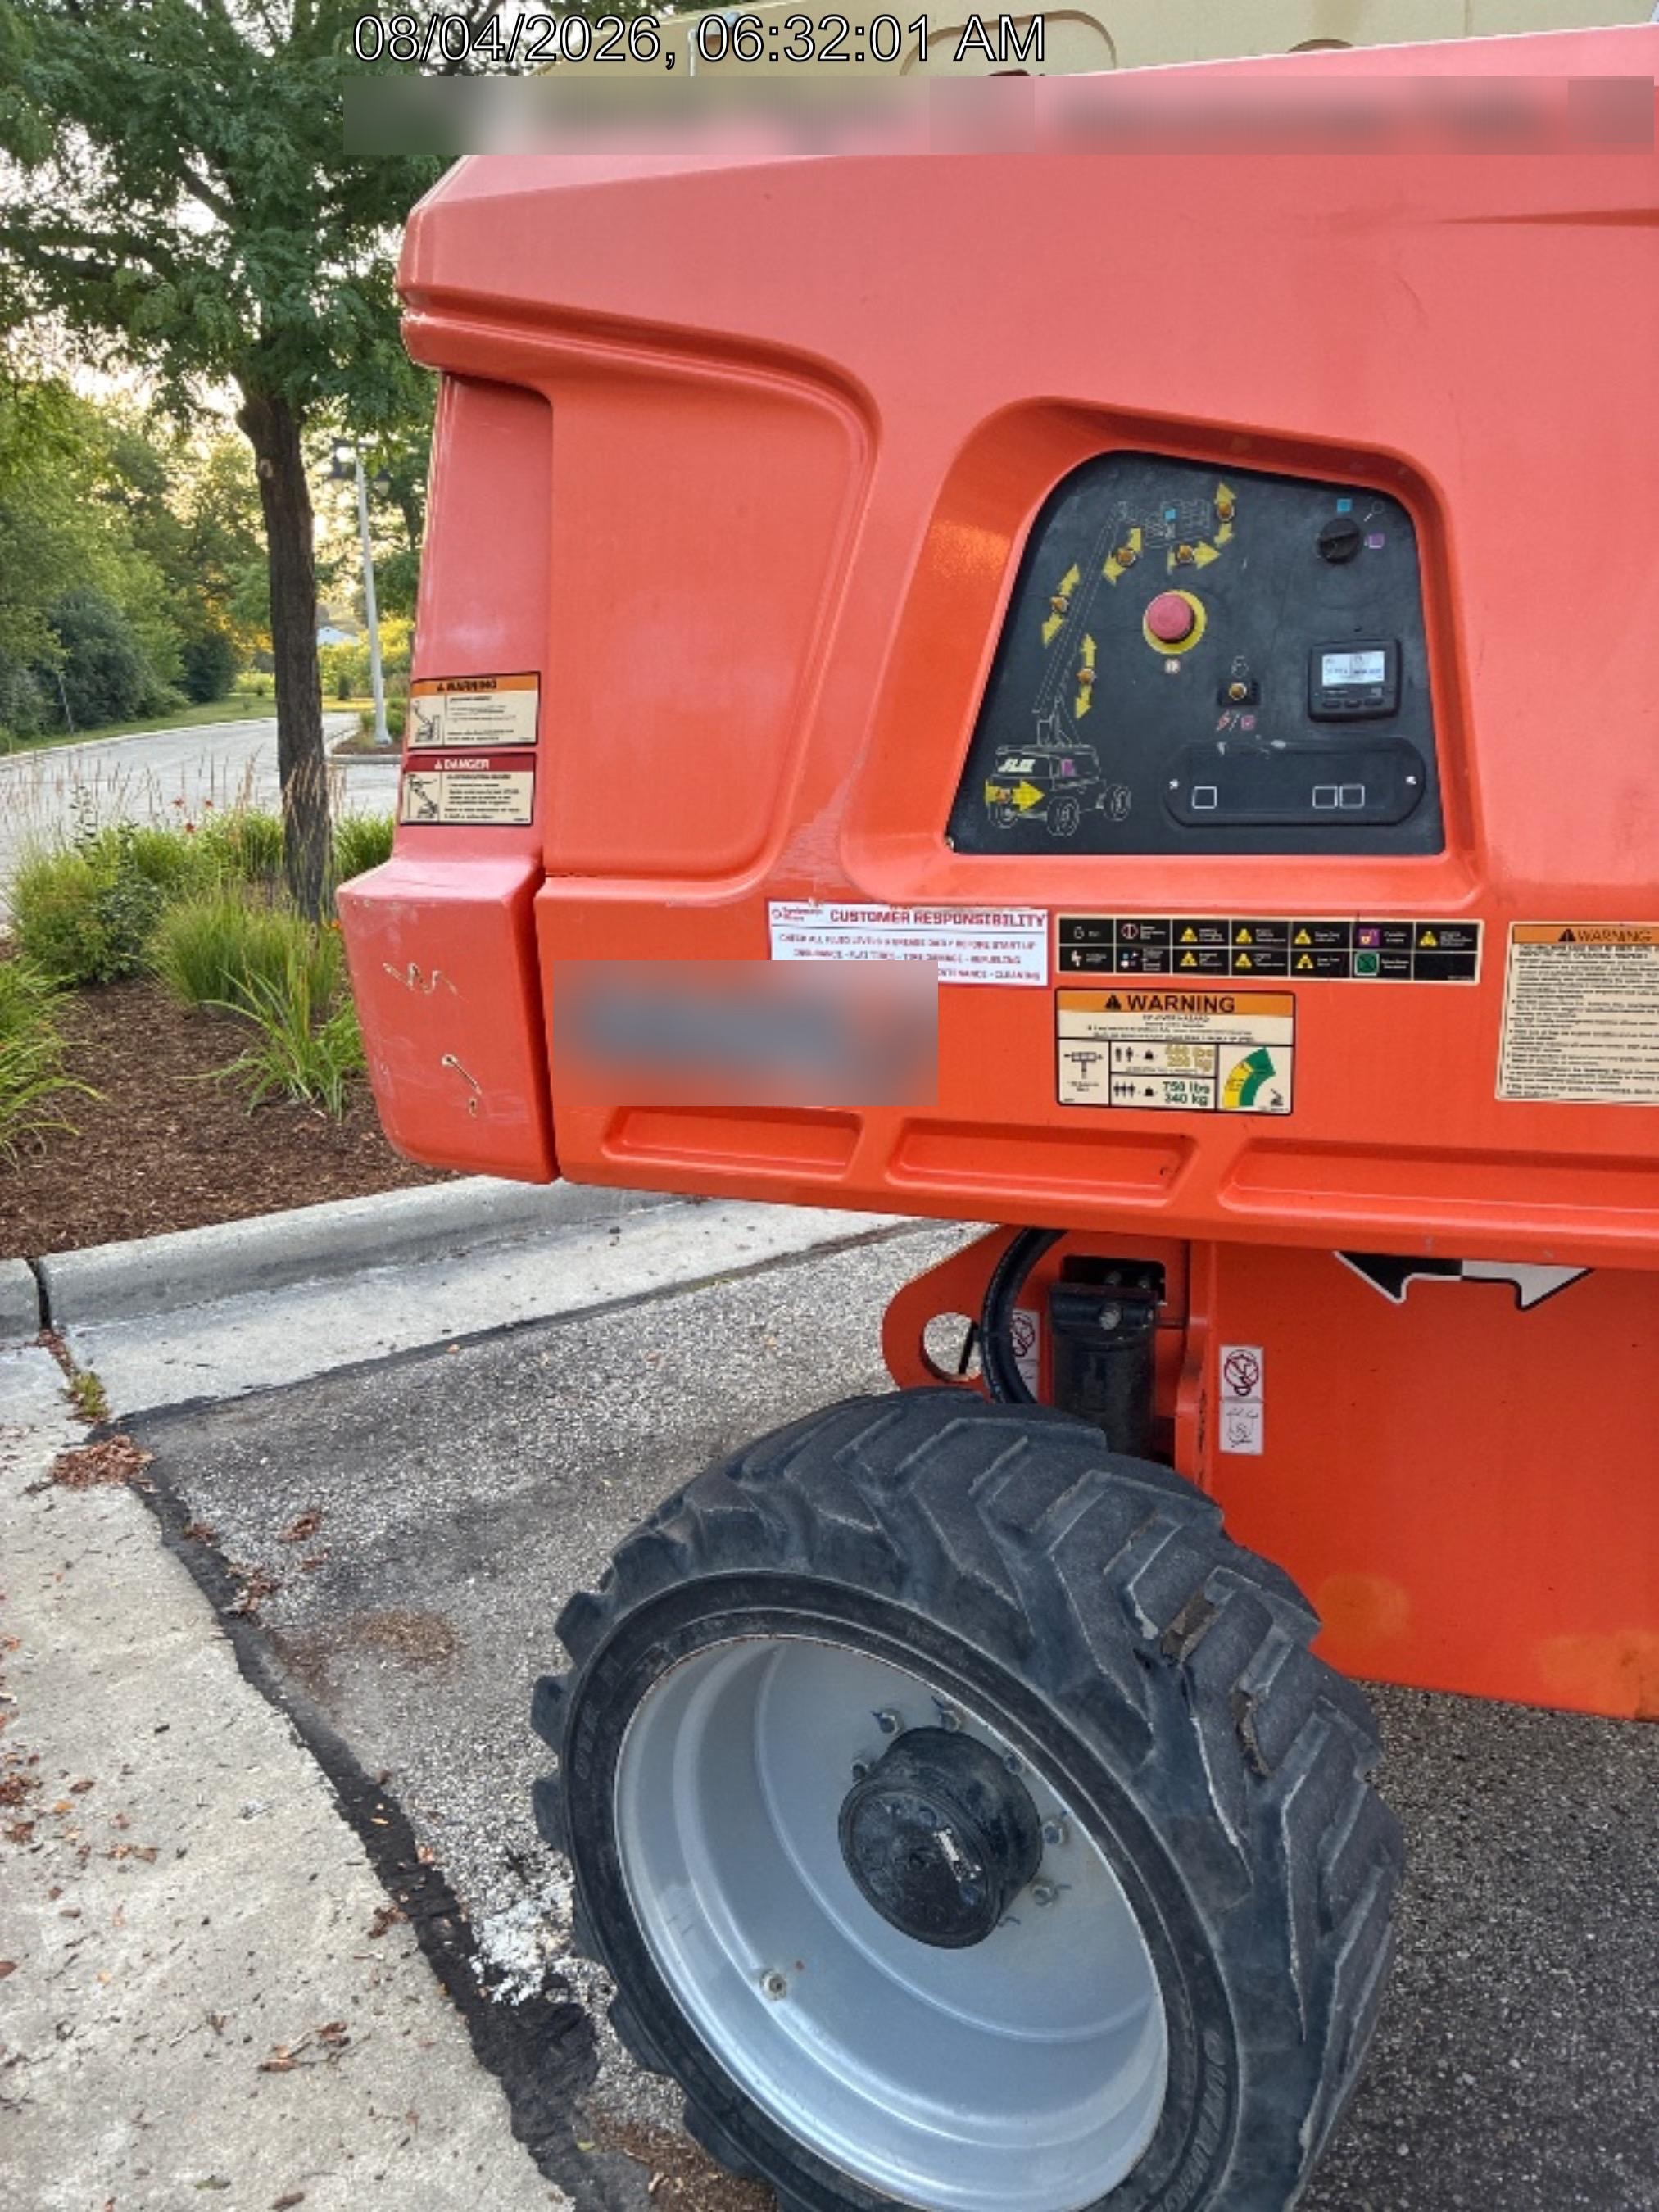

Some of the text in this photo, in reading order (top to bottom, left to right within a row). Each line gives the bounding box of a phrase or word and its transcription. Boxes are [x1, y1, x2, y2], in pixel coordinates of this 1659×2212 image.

[444, 759, 490, 770] DANGER
[830, 909, 910, 924] CUSTOMER
[914, 910, 1046, 927] RESPONSIBILITY
[1577, 929, 1652, 942] WARNING
[1127, 994, 1235, 1013] WARNING
[1192, 1094, 1208, 1107] kg
